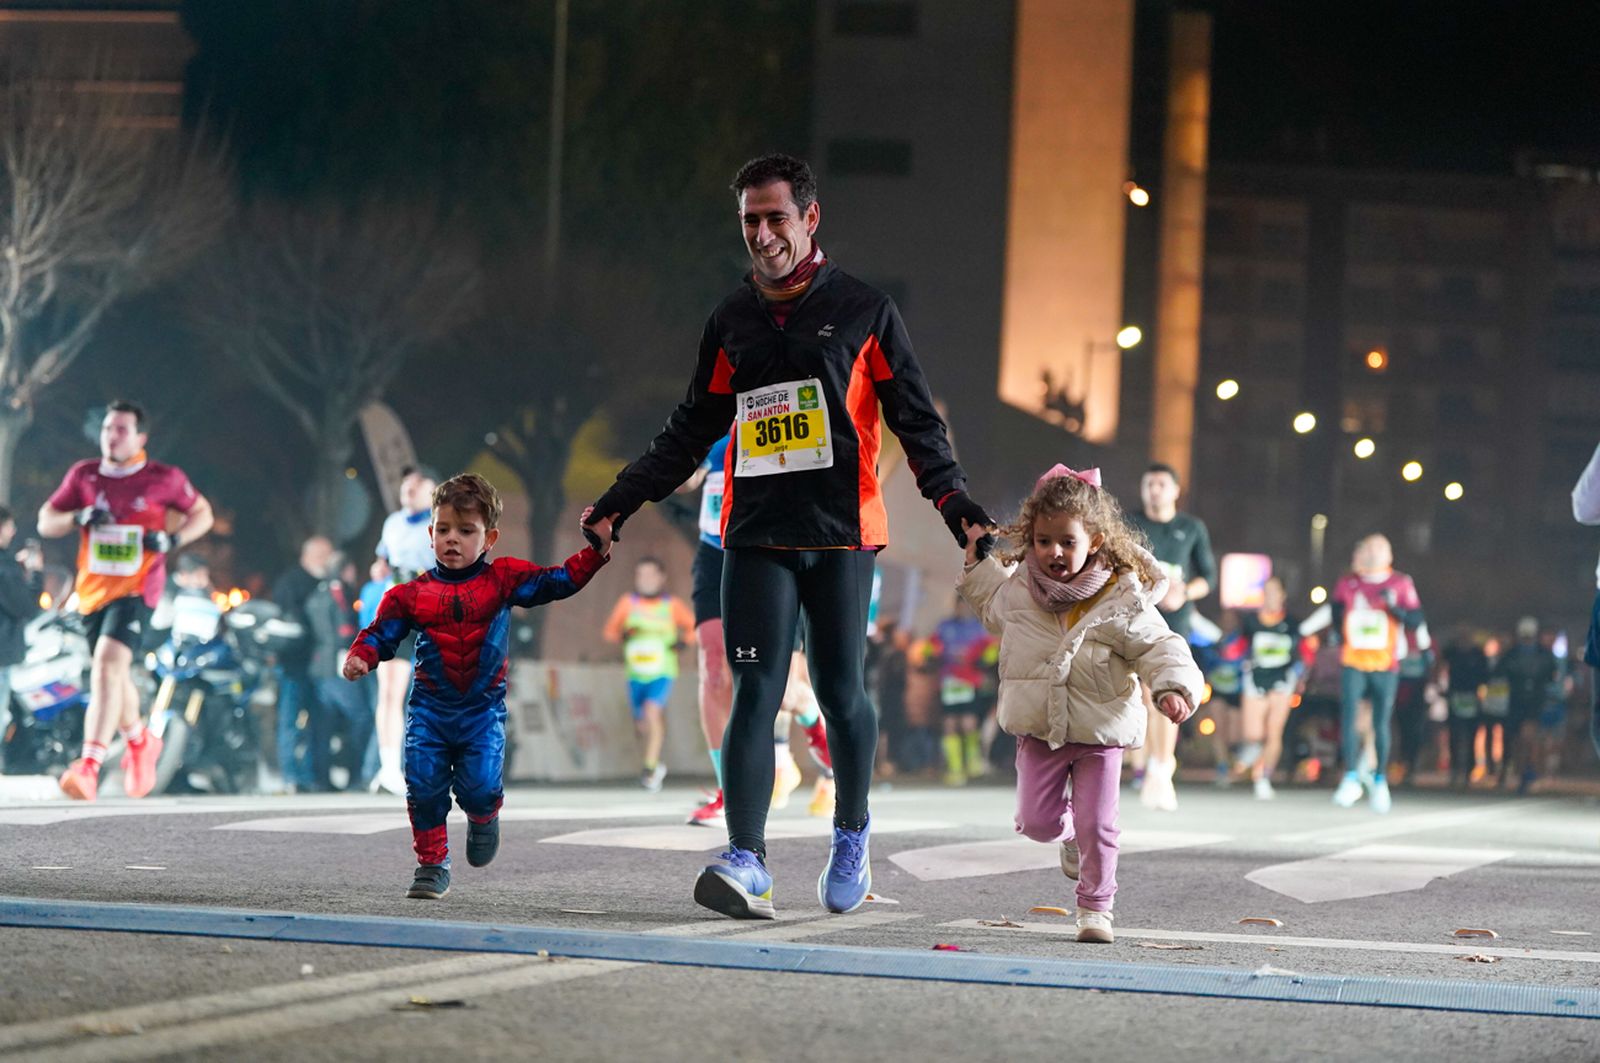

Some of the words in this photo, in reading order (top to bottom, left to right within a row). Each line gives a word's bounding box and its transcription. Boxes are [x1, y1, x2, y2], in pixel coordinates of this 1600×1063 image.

[755, 395, 777, 408] NOCHE
[778, 393, 789, 402] DE
[748, 411, 762, 421] SAN
[763, 403, 789, 417] ANTÓN
[756, 413, 809, 447] 3616
